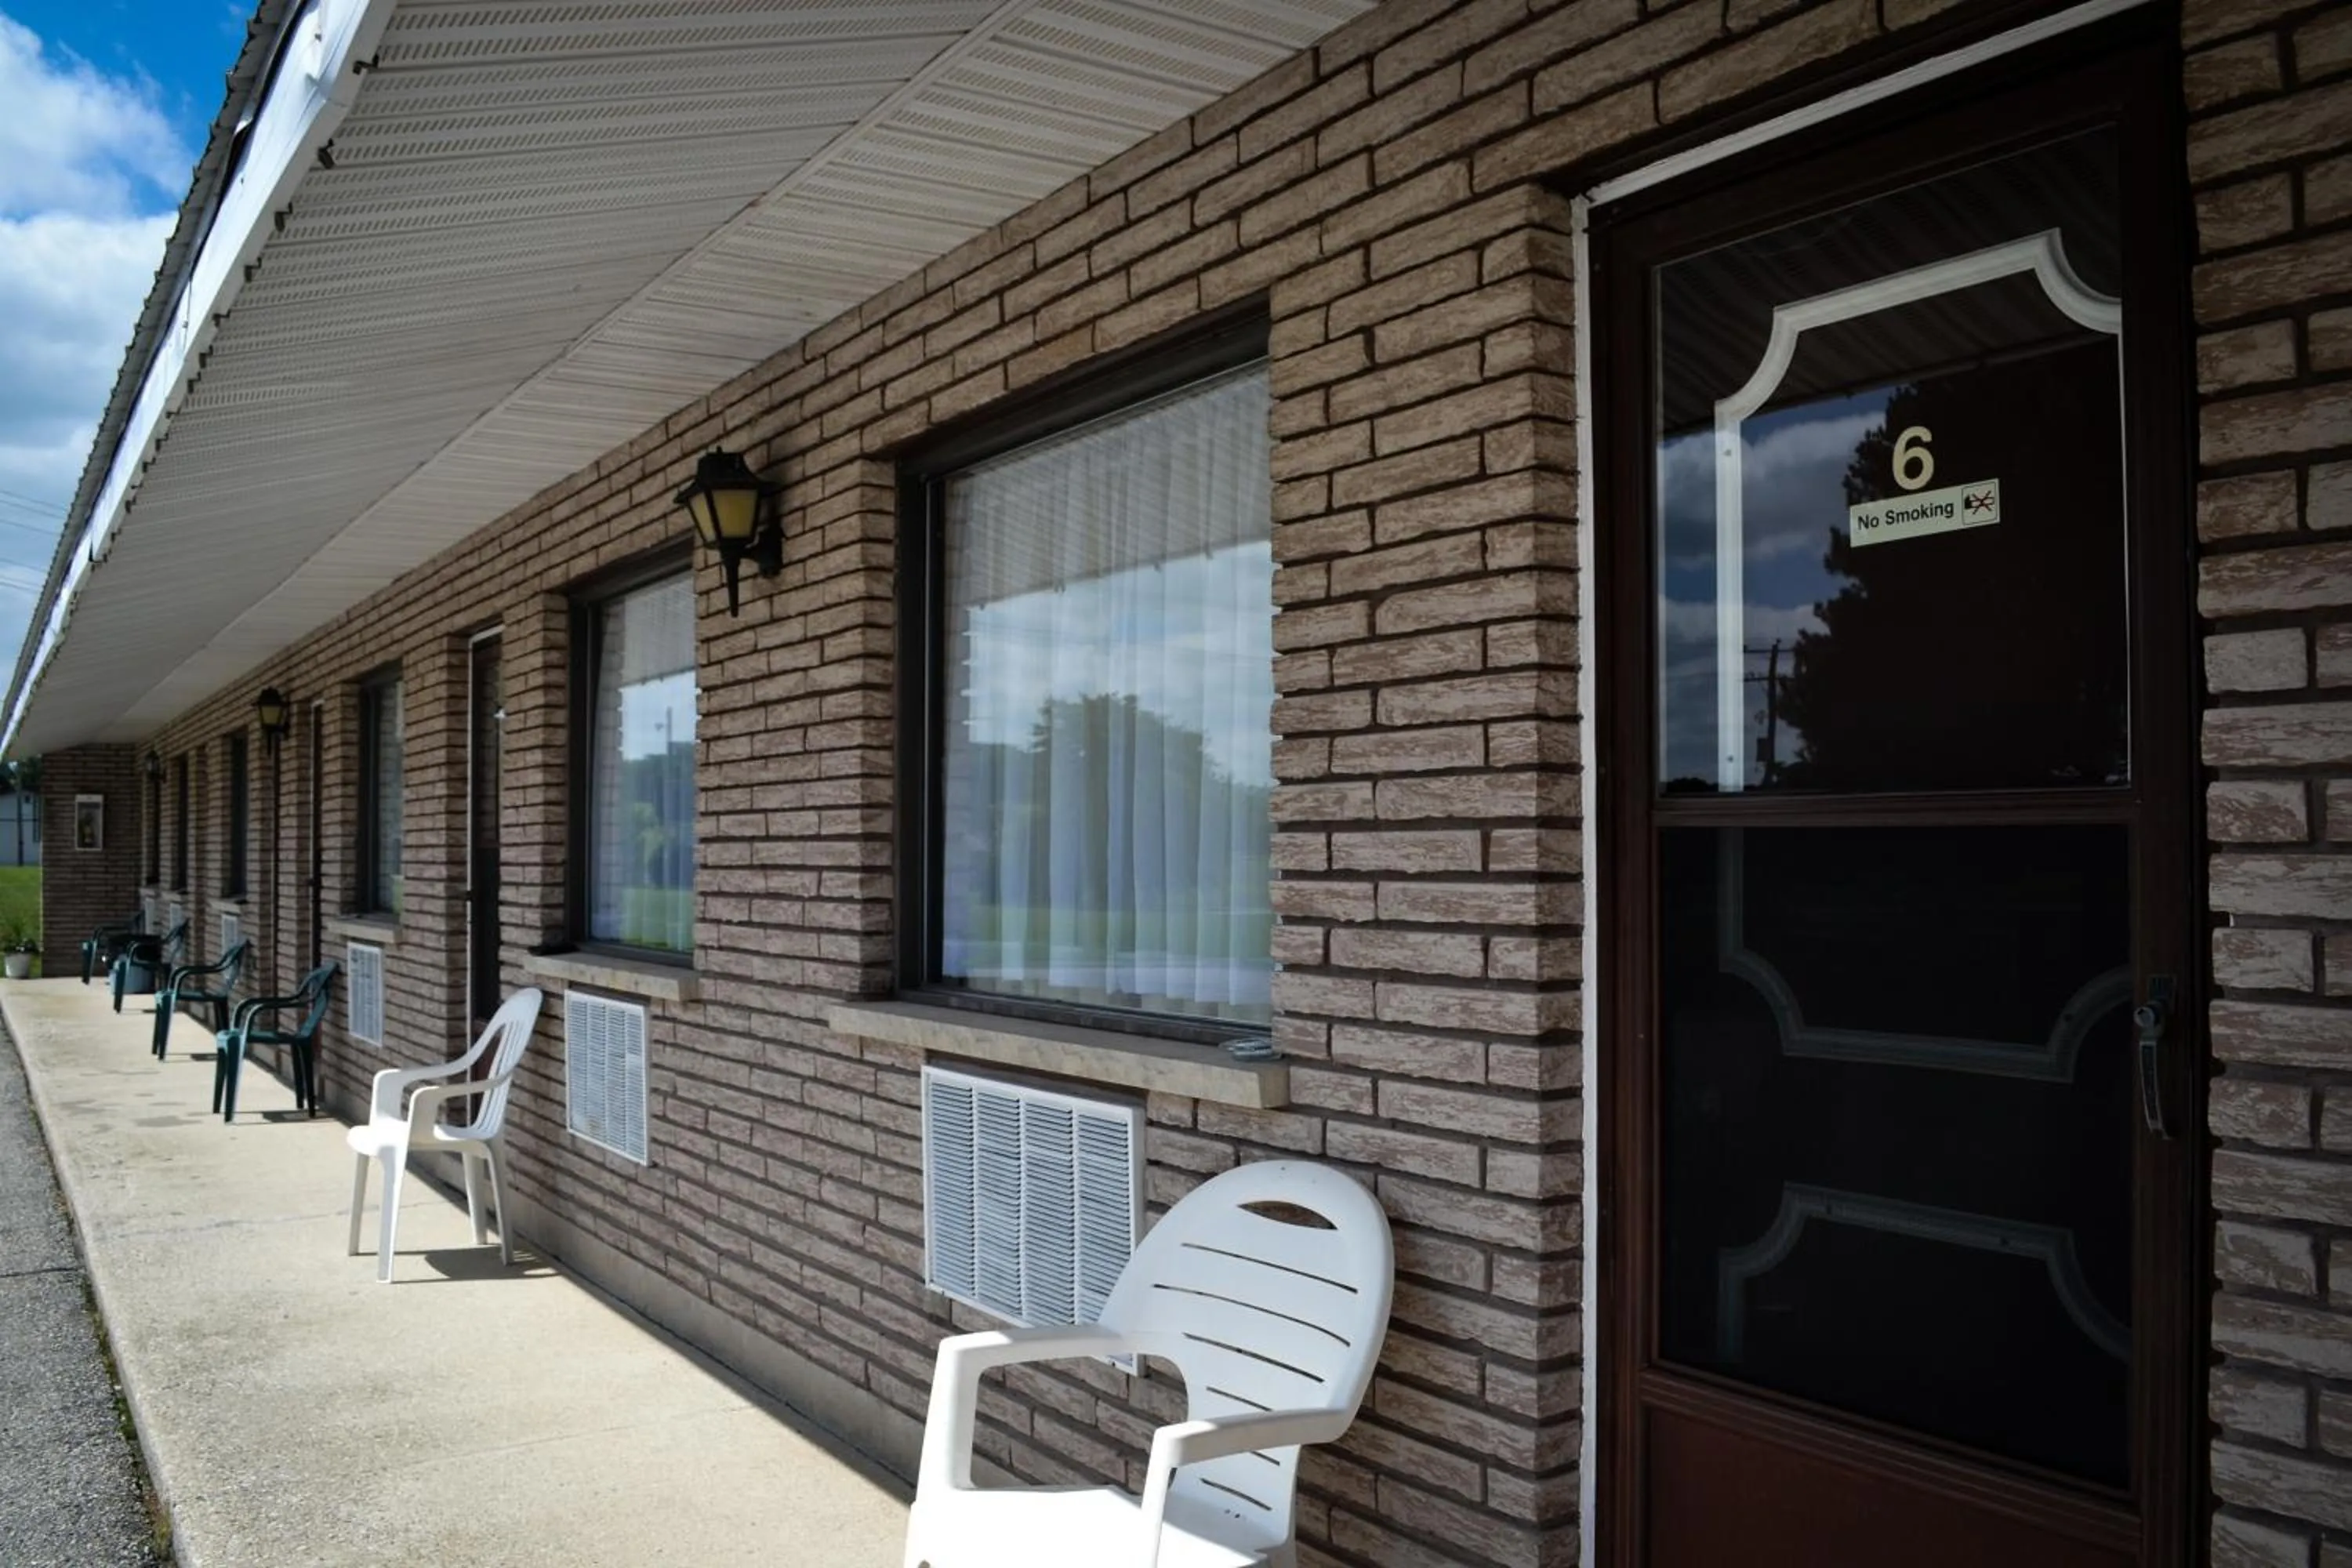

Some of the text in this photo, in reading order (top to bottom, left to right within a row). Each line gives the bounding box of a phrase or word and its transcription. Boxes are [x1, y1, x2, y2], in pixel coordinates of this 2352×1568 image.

[1893, 426, 1934, 490] 6
[1857, 502, 1955, 530] No Smoking
